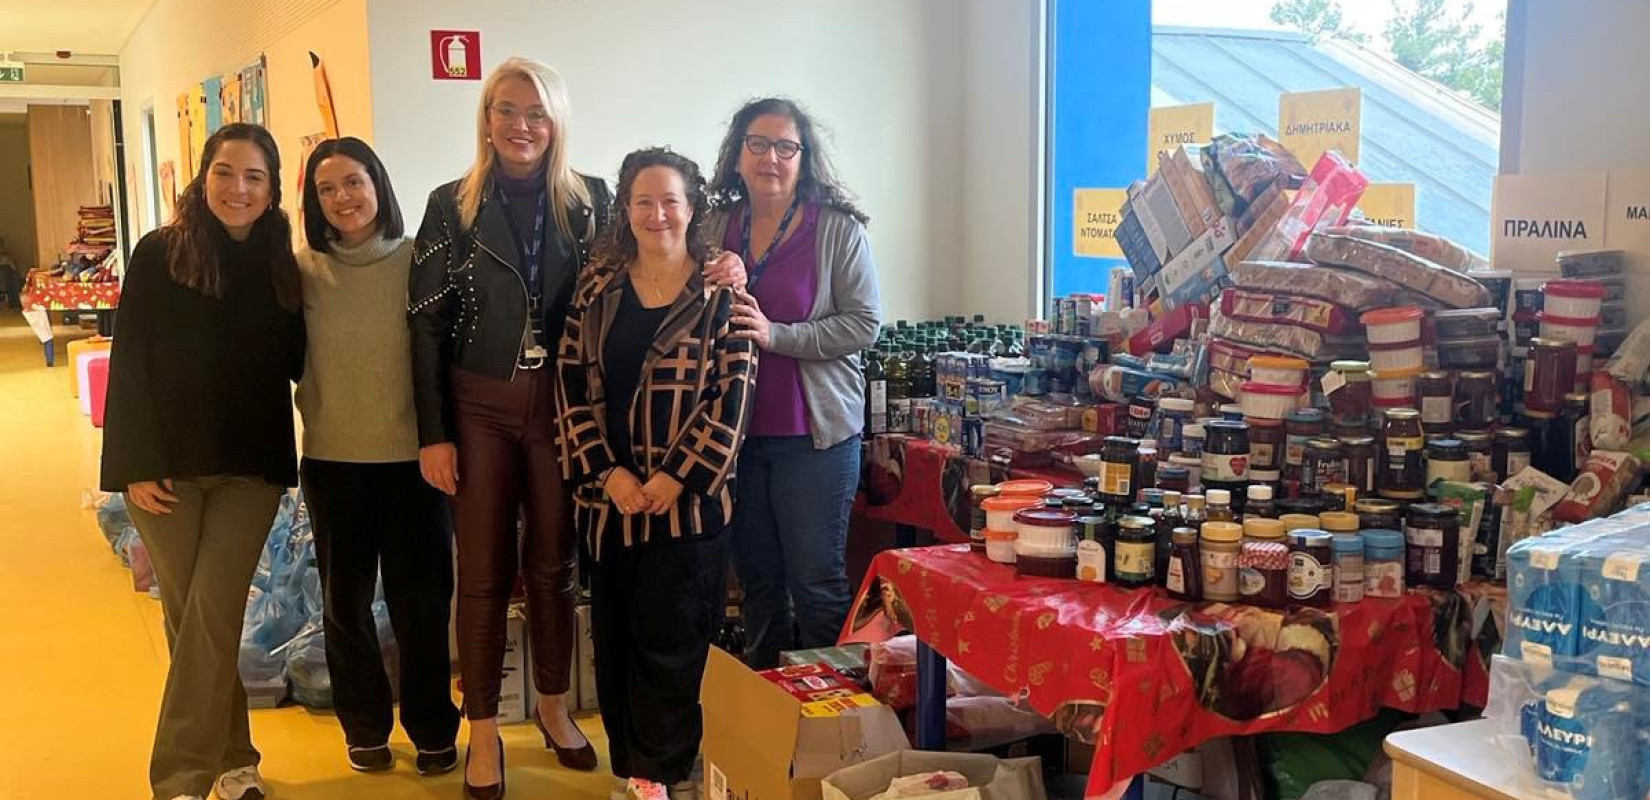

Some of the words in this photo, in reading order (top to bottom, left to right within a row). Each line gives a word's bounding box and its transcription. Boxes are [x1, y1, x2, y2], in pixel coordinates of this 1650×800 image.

[1286, 120, 1350, 136] ΔΗΜΗΤΡΙΑΚΑ
[1164, 132, 1195, 144] ΧΥΜΟΣ
[1087, 213, 1117, 224] ΣΑΛΤΣΑ
[1626, 206, 1650, 219] ΜΑ
[1081, 227, 1115, 238] ΝΤΟΜΑΤ
[1504, 219, 1587, 238] ΠΡΑΛΙΝΑ
[1583, 626, 1650, 648] ΑΛΕΥΡΙ
